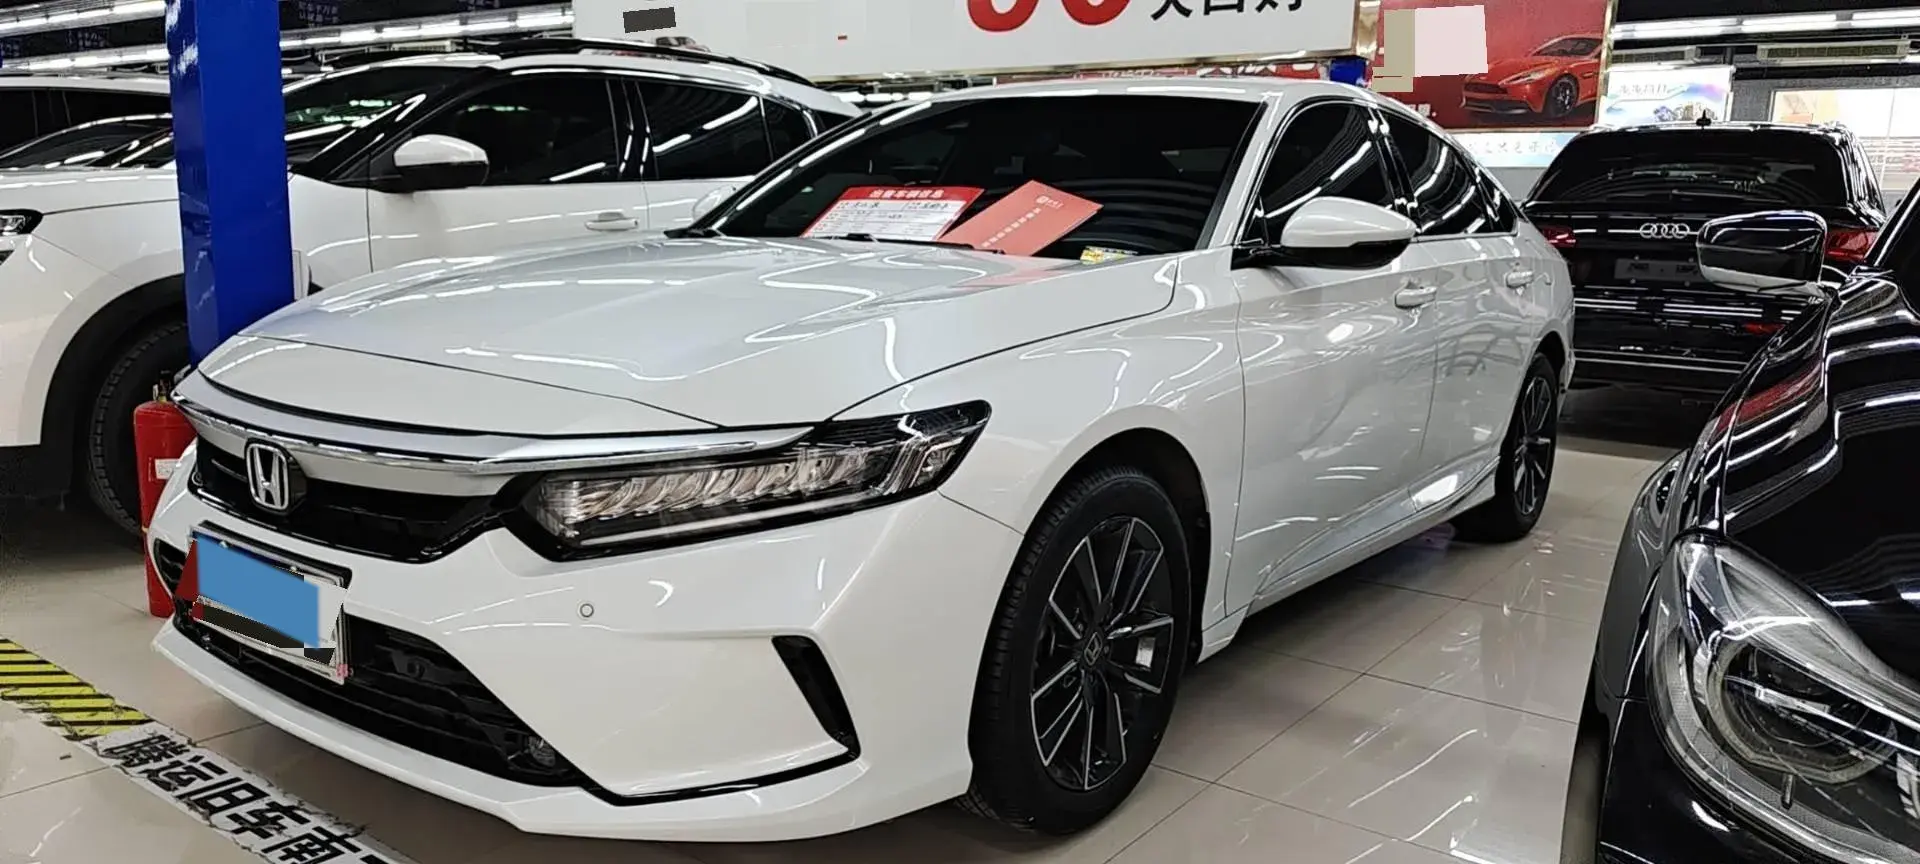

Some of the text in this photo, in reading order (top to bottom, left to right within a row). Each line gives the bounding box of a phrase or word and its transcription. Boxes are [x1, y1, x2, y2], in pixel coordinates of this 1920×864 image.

[102, 734, 398, 864] 腾运旧车南
